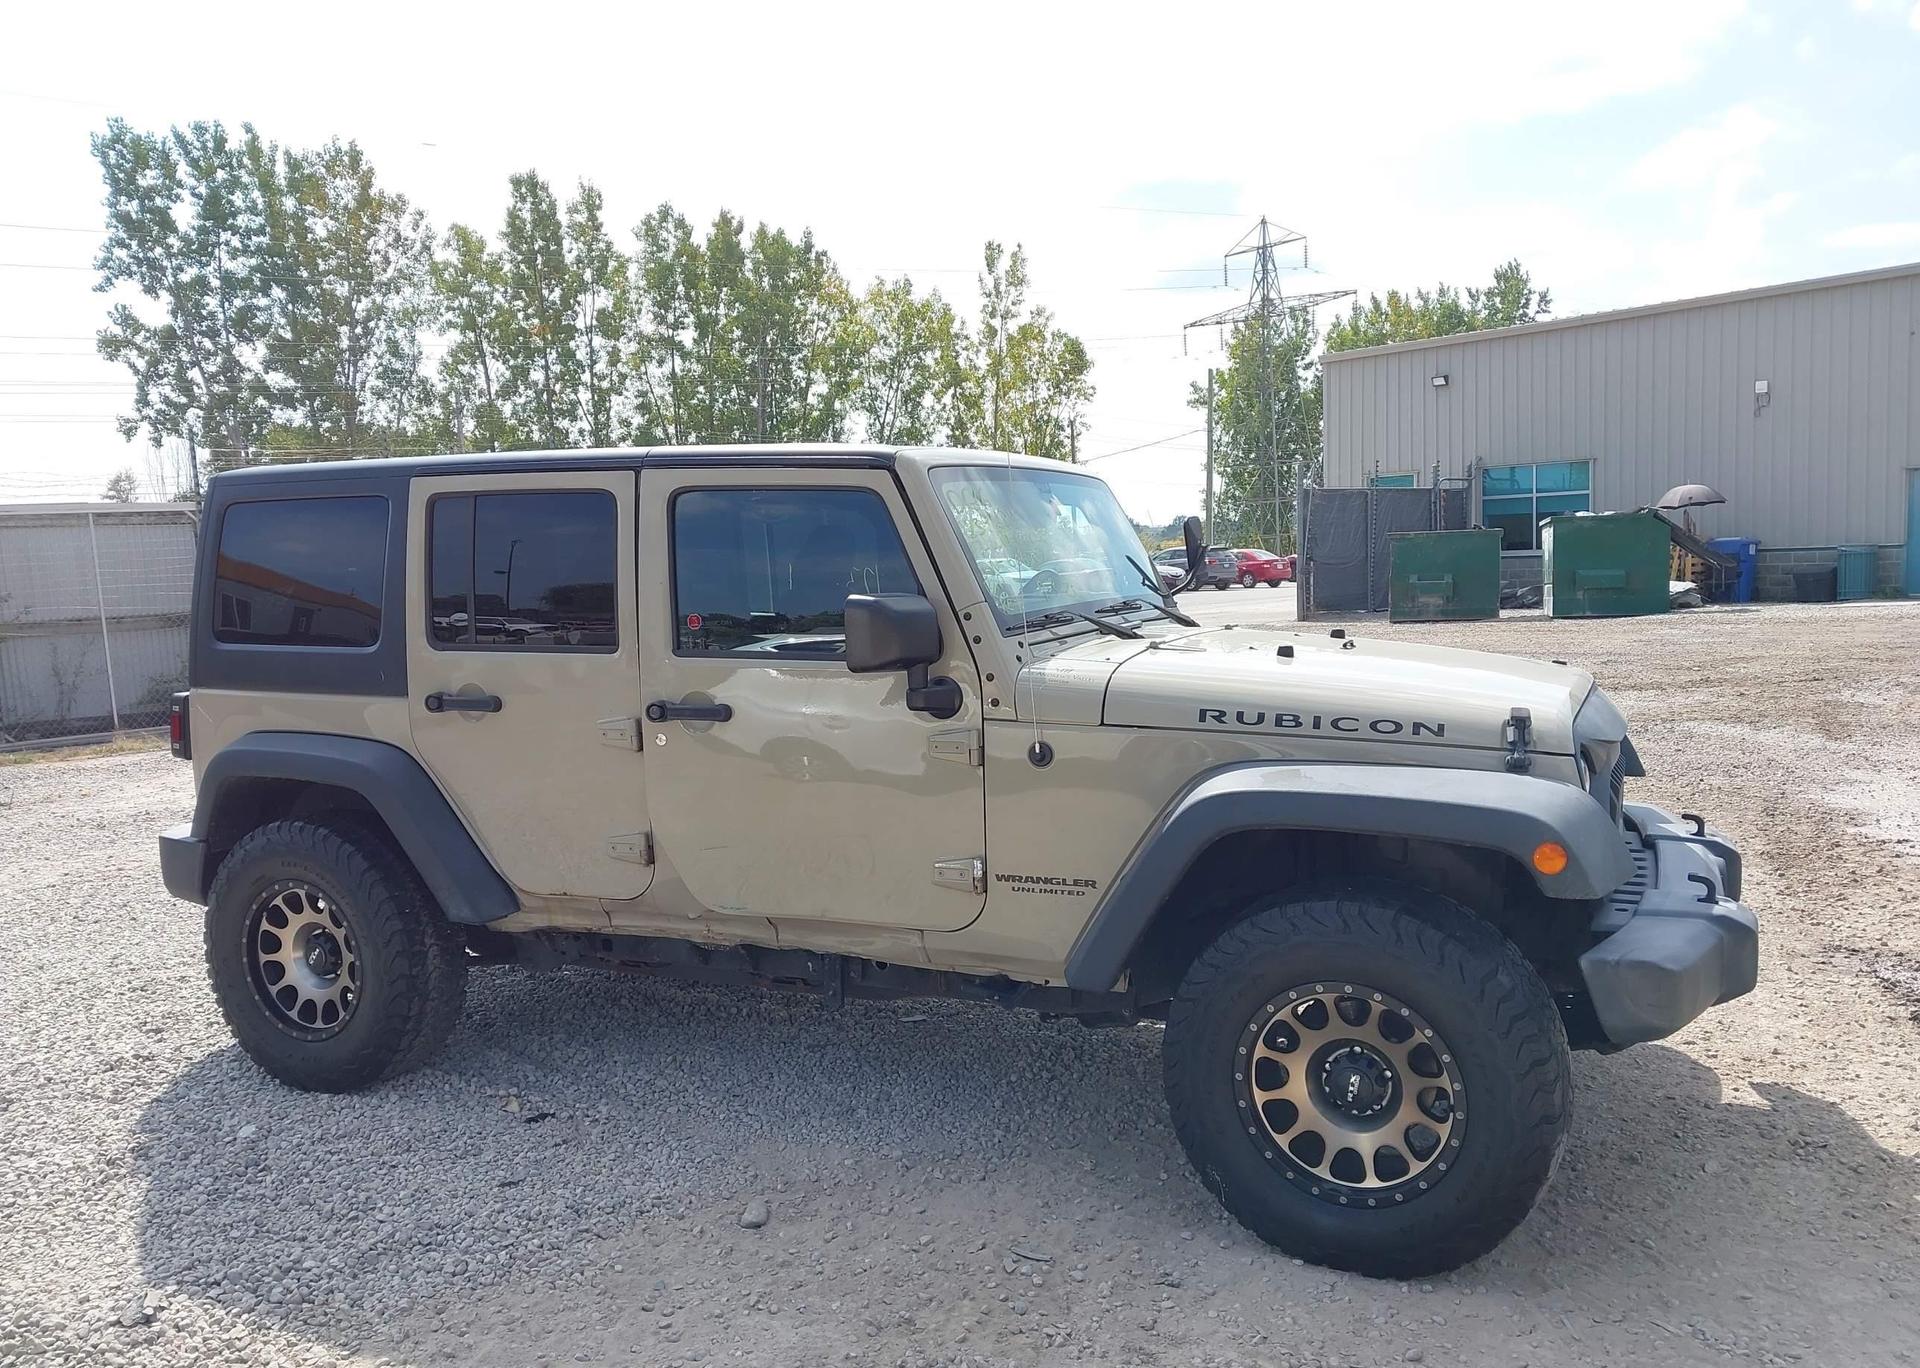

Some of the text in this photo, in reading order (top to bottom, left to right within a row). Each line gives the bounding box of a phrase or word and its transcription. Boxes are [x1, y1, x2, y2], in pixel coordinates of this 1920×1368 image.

[1198, 708, 1445, 737] RUBICON
[995, 874, 1098, 889] WRANGLER
[1012, 886, 1086, 897] UNLIMITED
